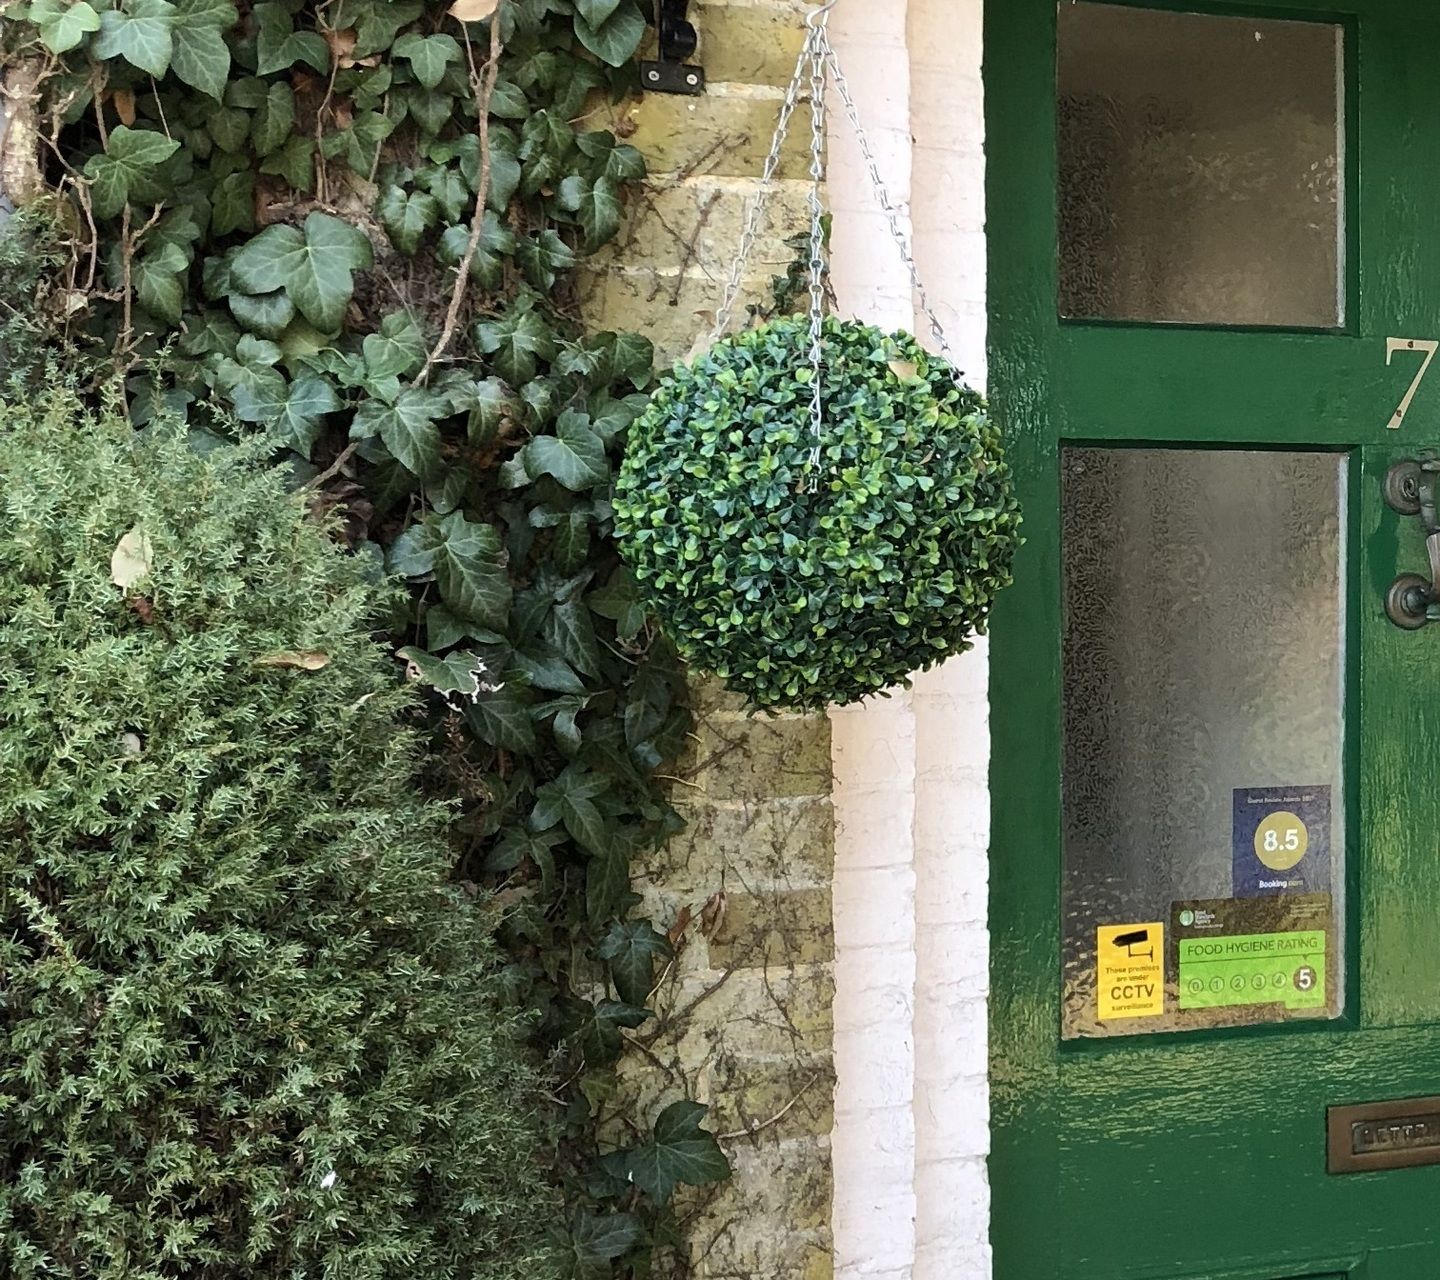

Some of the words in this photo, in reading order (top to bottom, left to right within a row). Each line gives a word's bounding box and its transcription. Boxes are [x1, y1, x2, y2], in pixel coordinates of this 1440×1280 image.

[1386, 337, 1440, 429] 7
[1263, 829, 1299, 851] 8.5
[1187, 944, 1223, 956] FOOD
[1226, 940, 1275, 954] HYGIENE
[1277, 937, 1318, 951] RATING
[1298, 968, 1311, 989] 5
[1111, 983, 1155, 1000] CCTV
